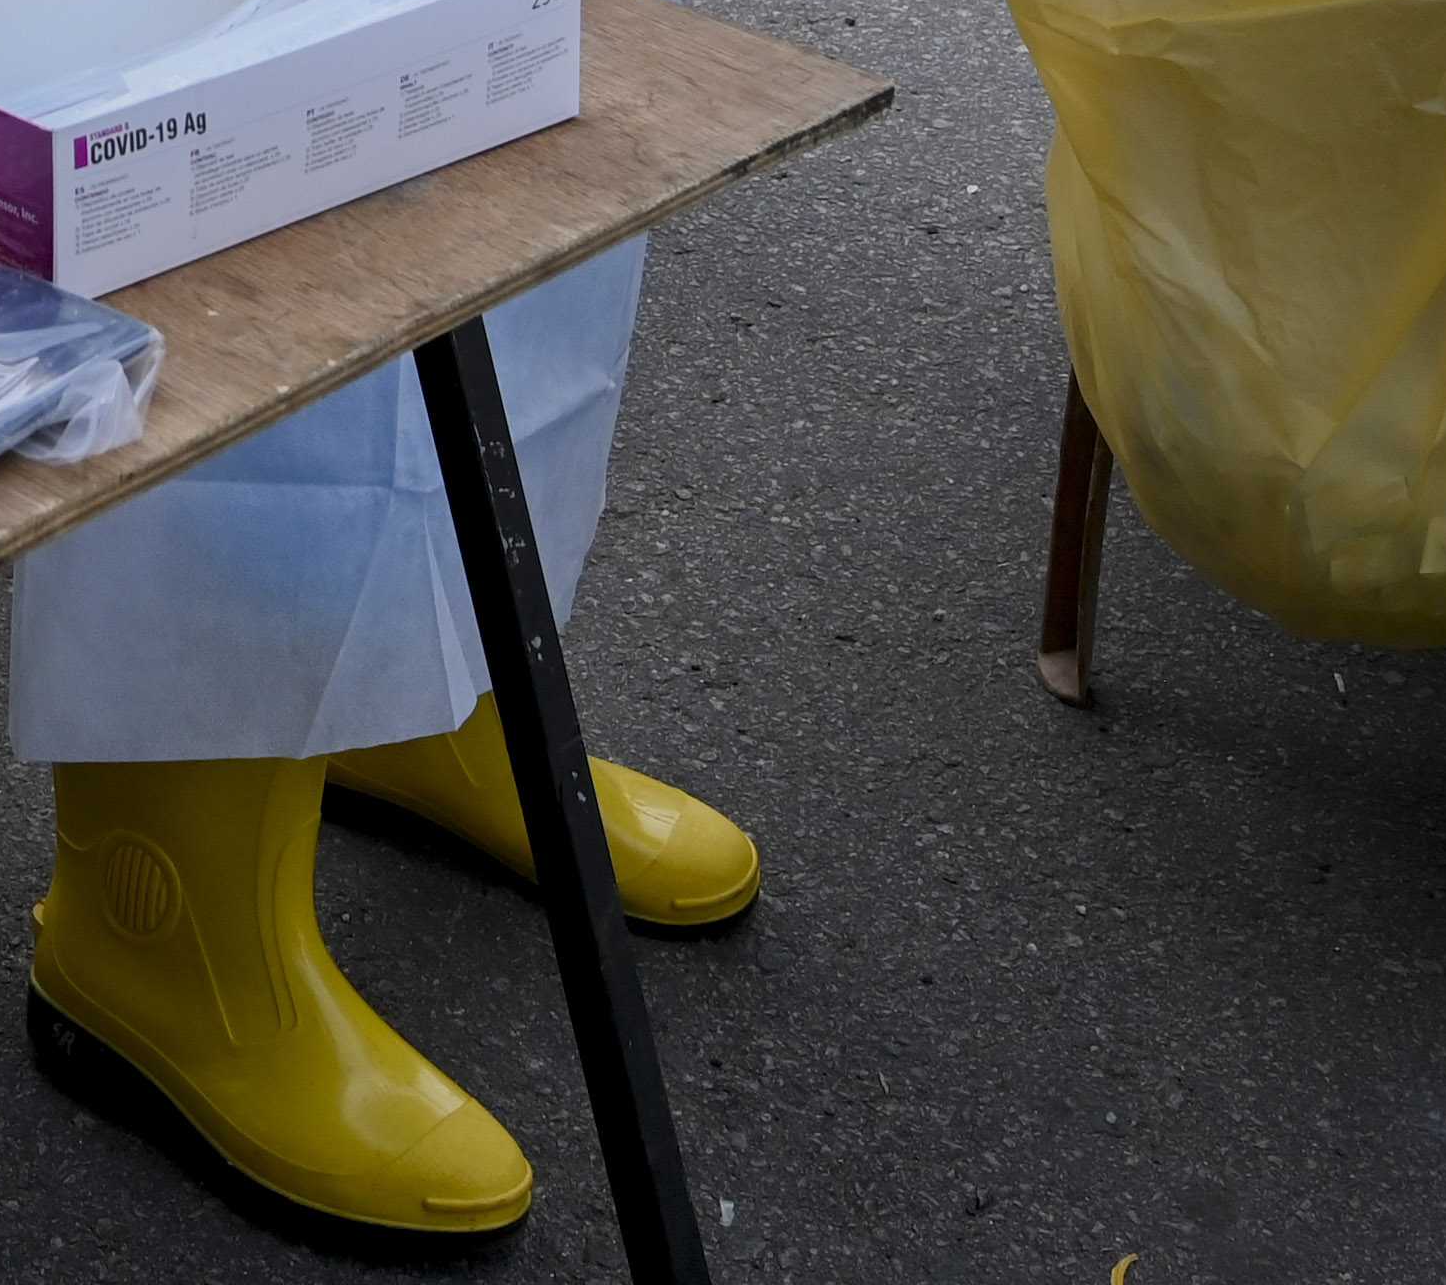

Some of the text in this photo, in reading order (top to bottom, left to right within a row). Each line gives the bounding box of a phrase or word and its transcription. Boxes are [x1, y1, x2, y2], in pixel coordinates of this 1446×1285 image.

[90, 111, 207, 165] COVID-19 Ag
[21, 206, 39, 225] Inc.
